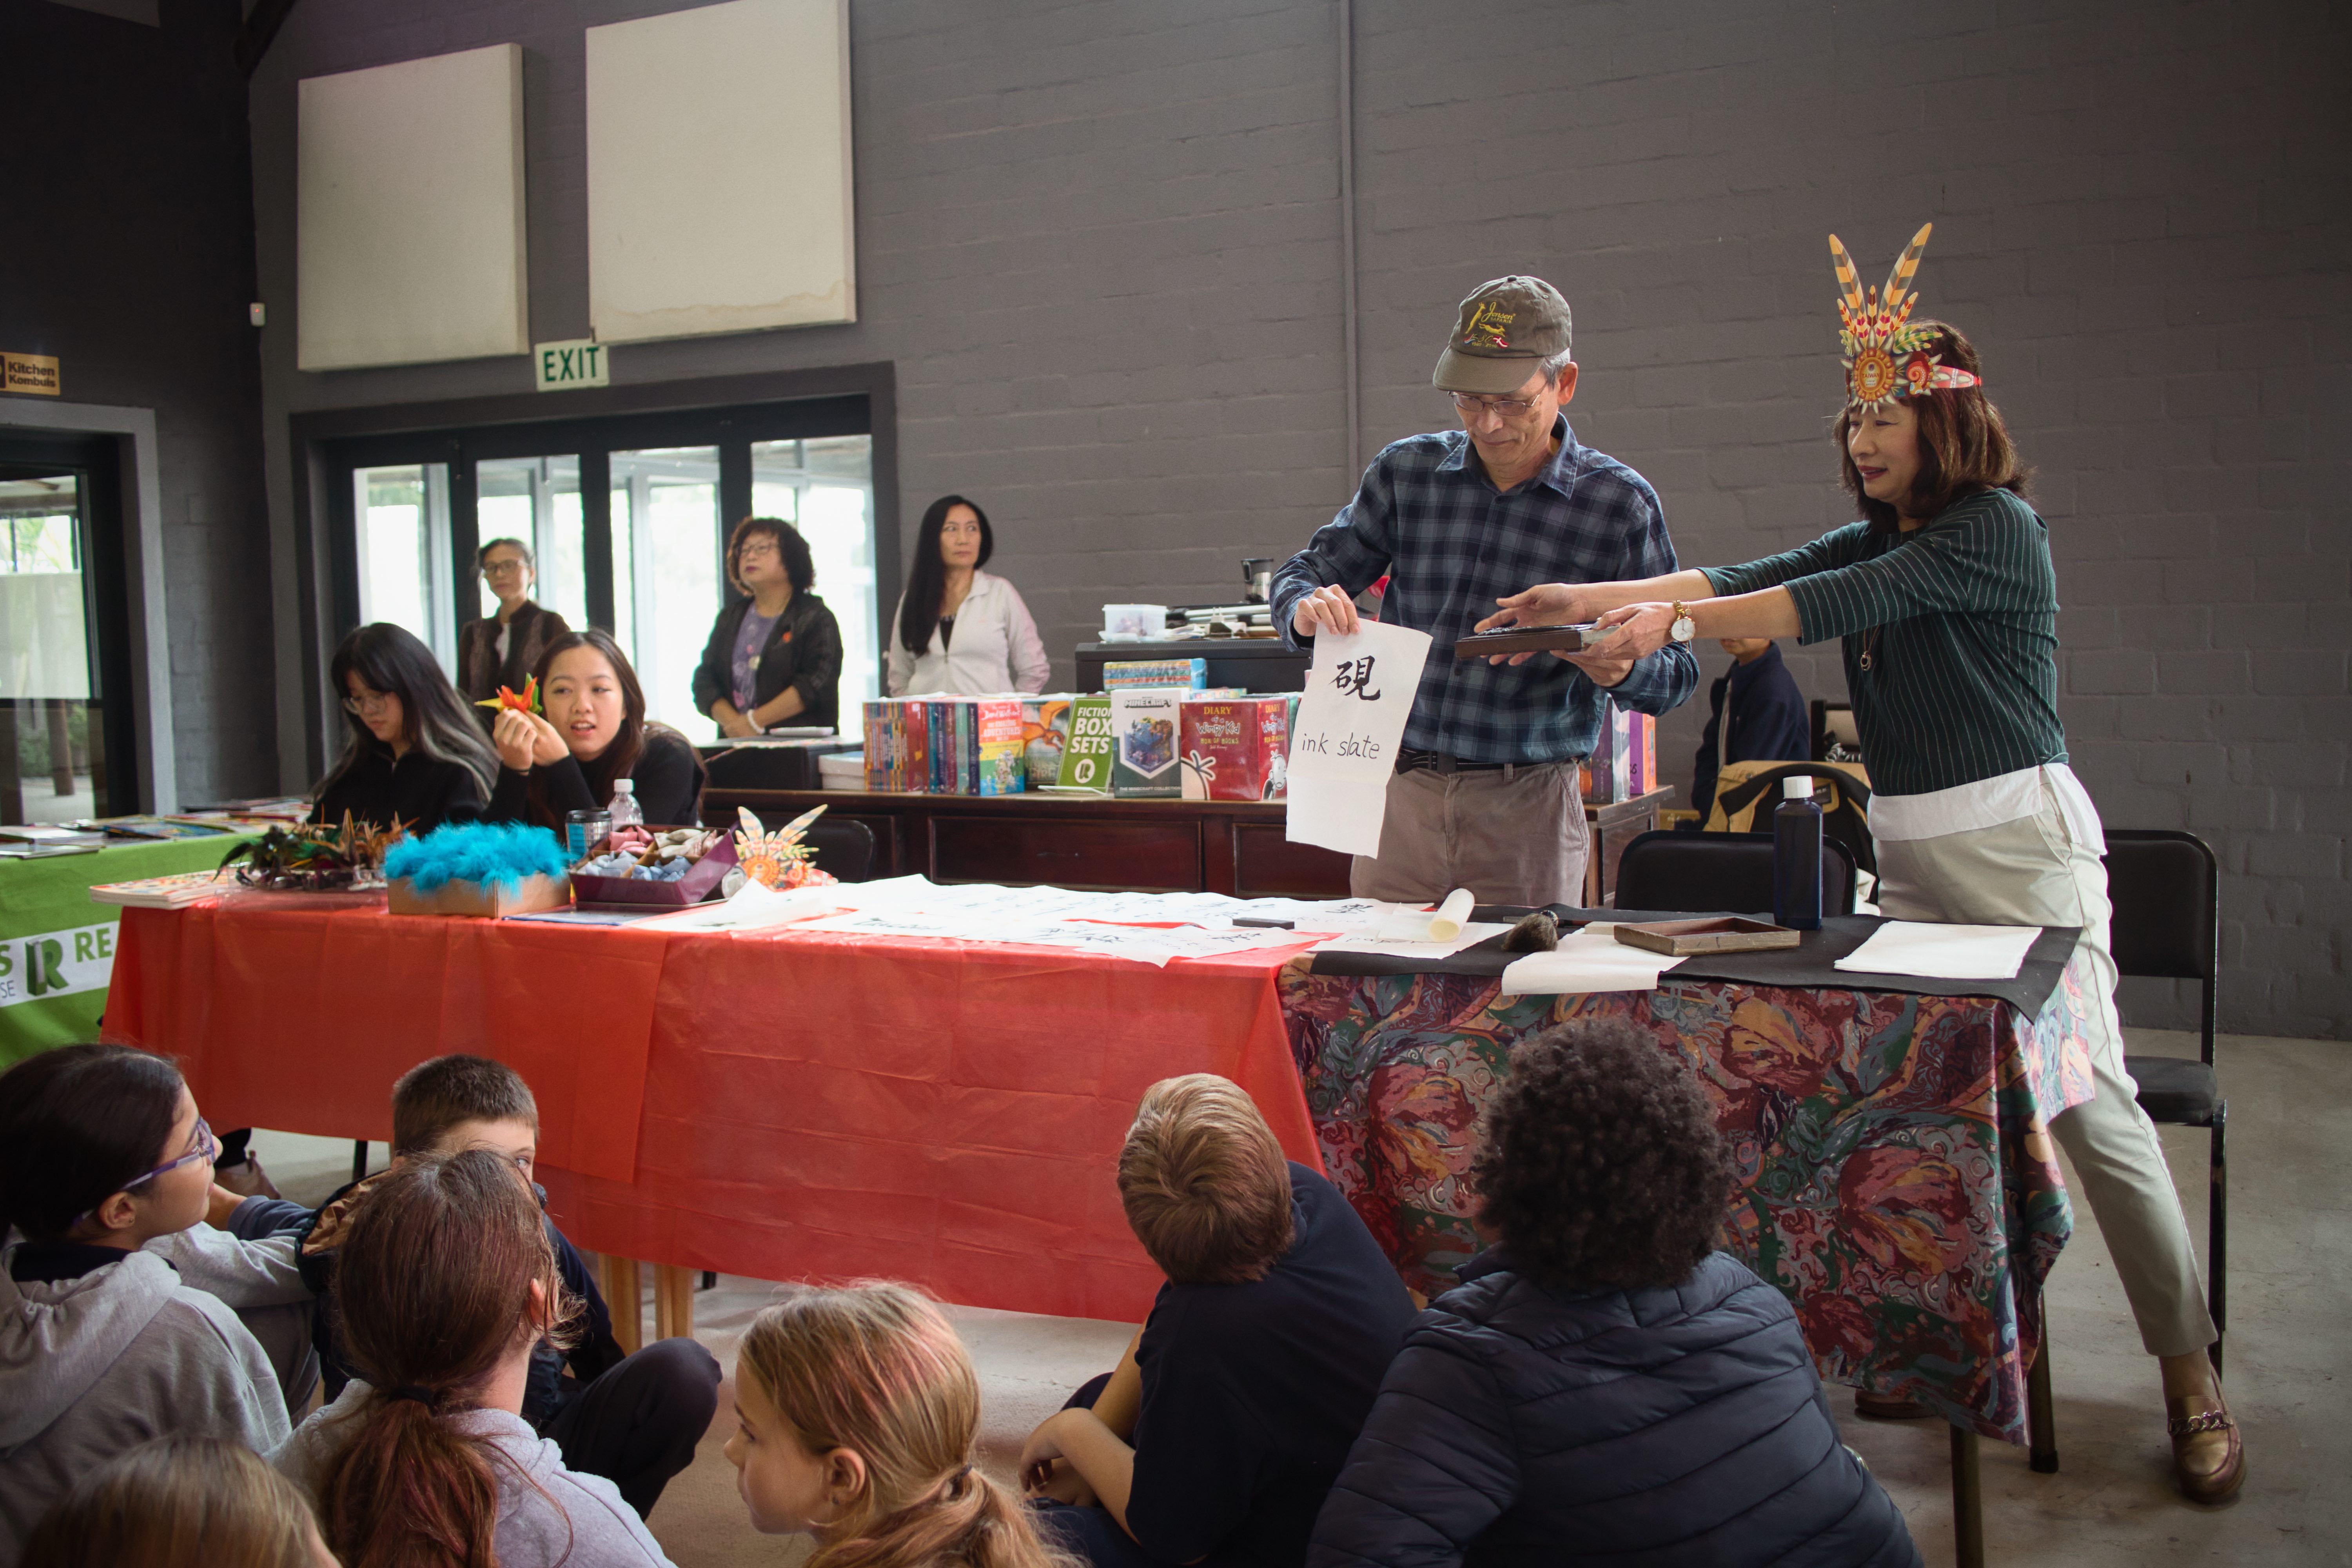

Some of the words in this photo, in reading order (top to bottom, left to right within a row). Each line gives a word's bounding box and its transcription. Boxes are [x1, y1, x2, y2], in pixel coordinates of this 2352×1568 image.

[8, 361, 55, 376] Kitchen
[543, 346, 599, 382] EXIT
[9, 375, 56, 388] Kombuis
[1328, 655, 1381, 701] 硯
[1123, 699, 1172, 709] MINECRAFT
[1203, 706, 1232, 715] DIARY
[1265, 703, 1280, 713] DIARY
[1074, 717, 1112, 736] BOX
[1211, 715, 1219, 723] of
[984, 727, 1020, 737] ADVENTURES
[1195, 722, 1225, 737] Wimpy
[1225, 720, 1240, 735] Kid
[1070, 736, 1110, 754] SETS
[1301, 733, 1329, 755] ink
[1337, 733, 1380, 760] slate
[74, 927, 113, 963] RE
